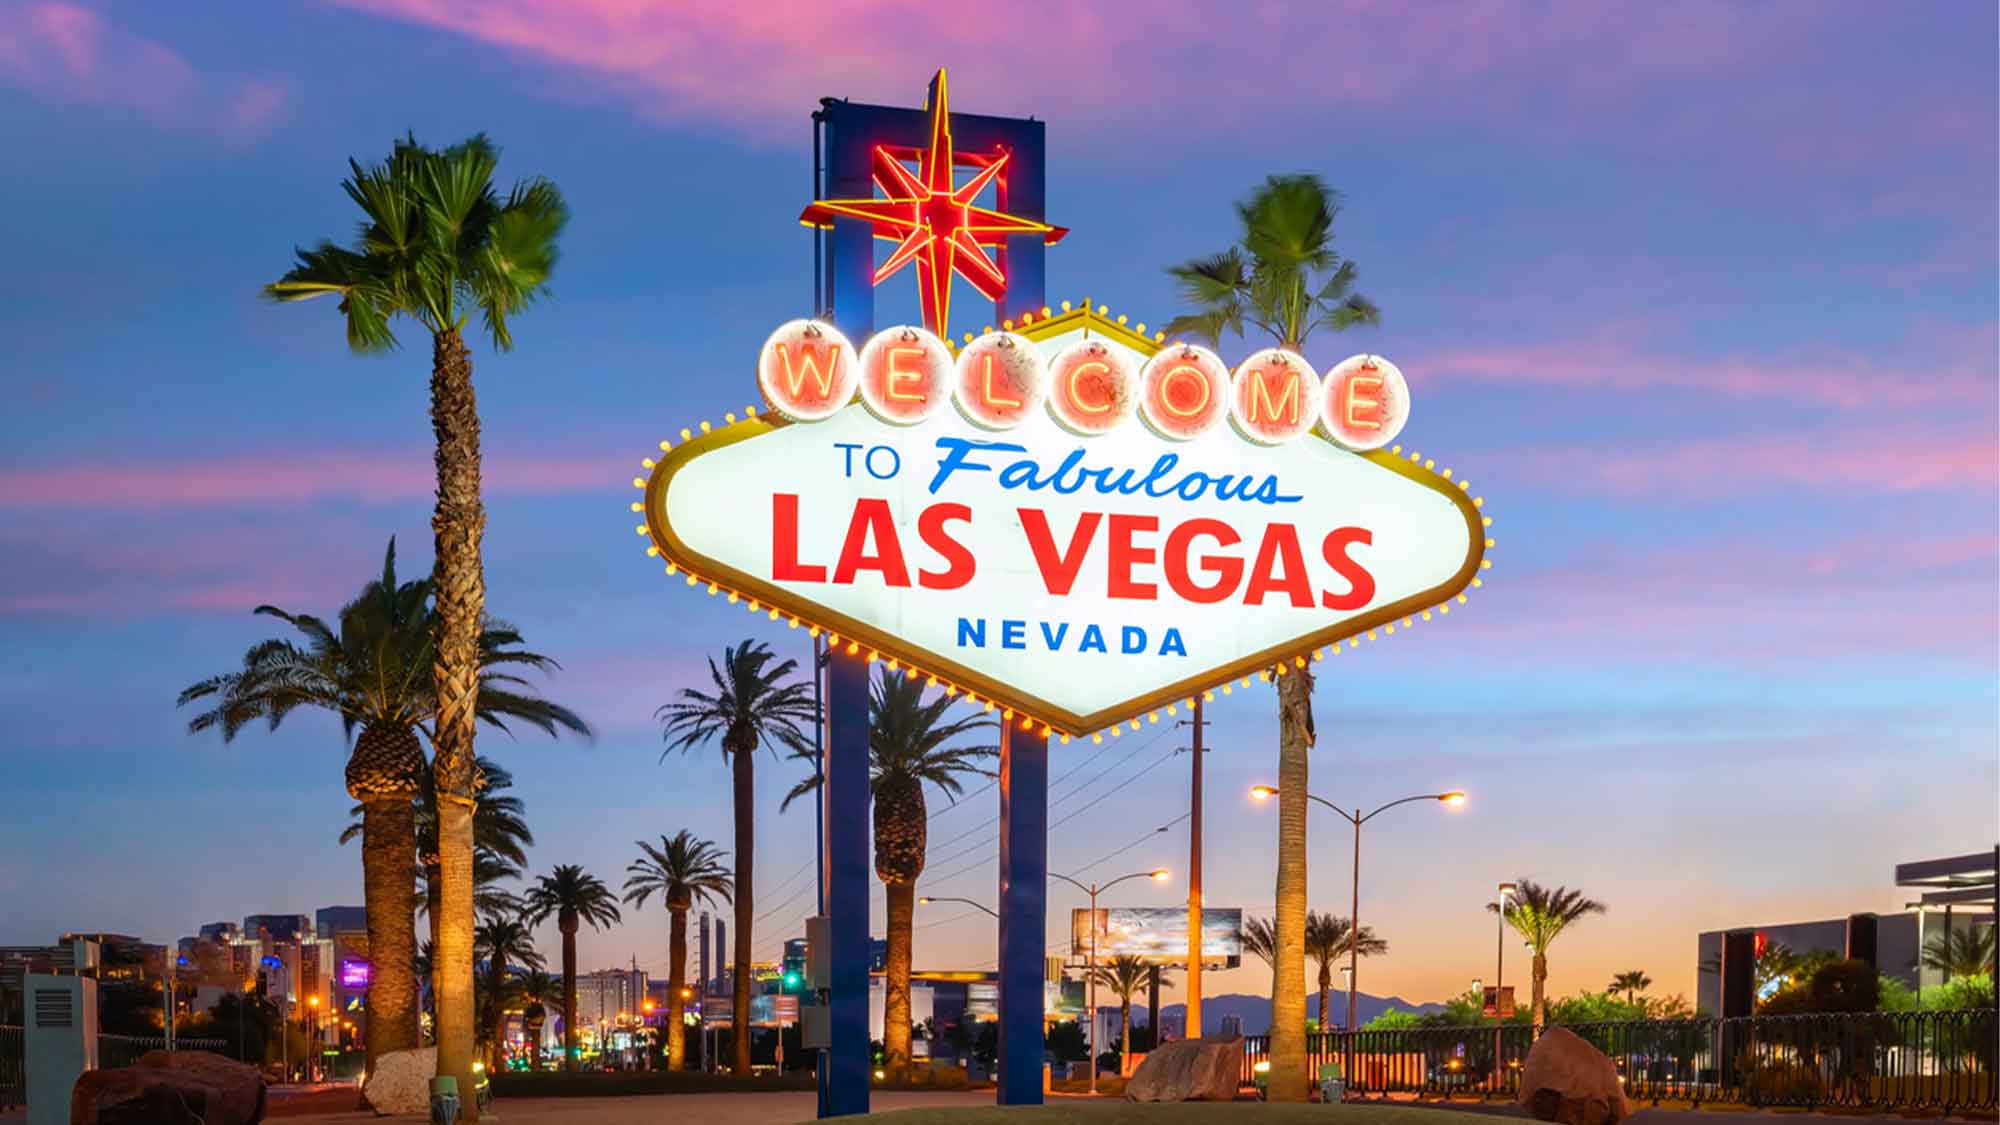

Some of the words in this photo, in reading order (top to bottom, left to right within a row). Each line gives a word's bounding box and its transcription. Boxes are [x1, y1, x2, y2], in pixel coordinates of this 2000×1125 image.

[776, 343, 1383, 429] WELCOME
[834, 443, 901, 481] TO
[928, 437, 1304, 506] Fabulous
[773, 493, 977, 591] LAS
[1017, 508, 1376, 612] VEGAS
[957, 618, 1188, 657] NEVADA
